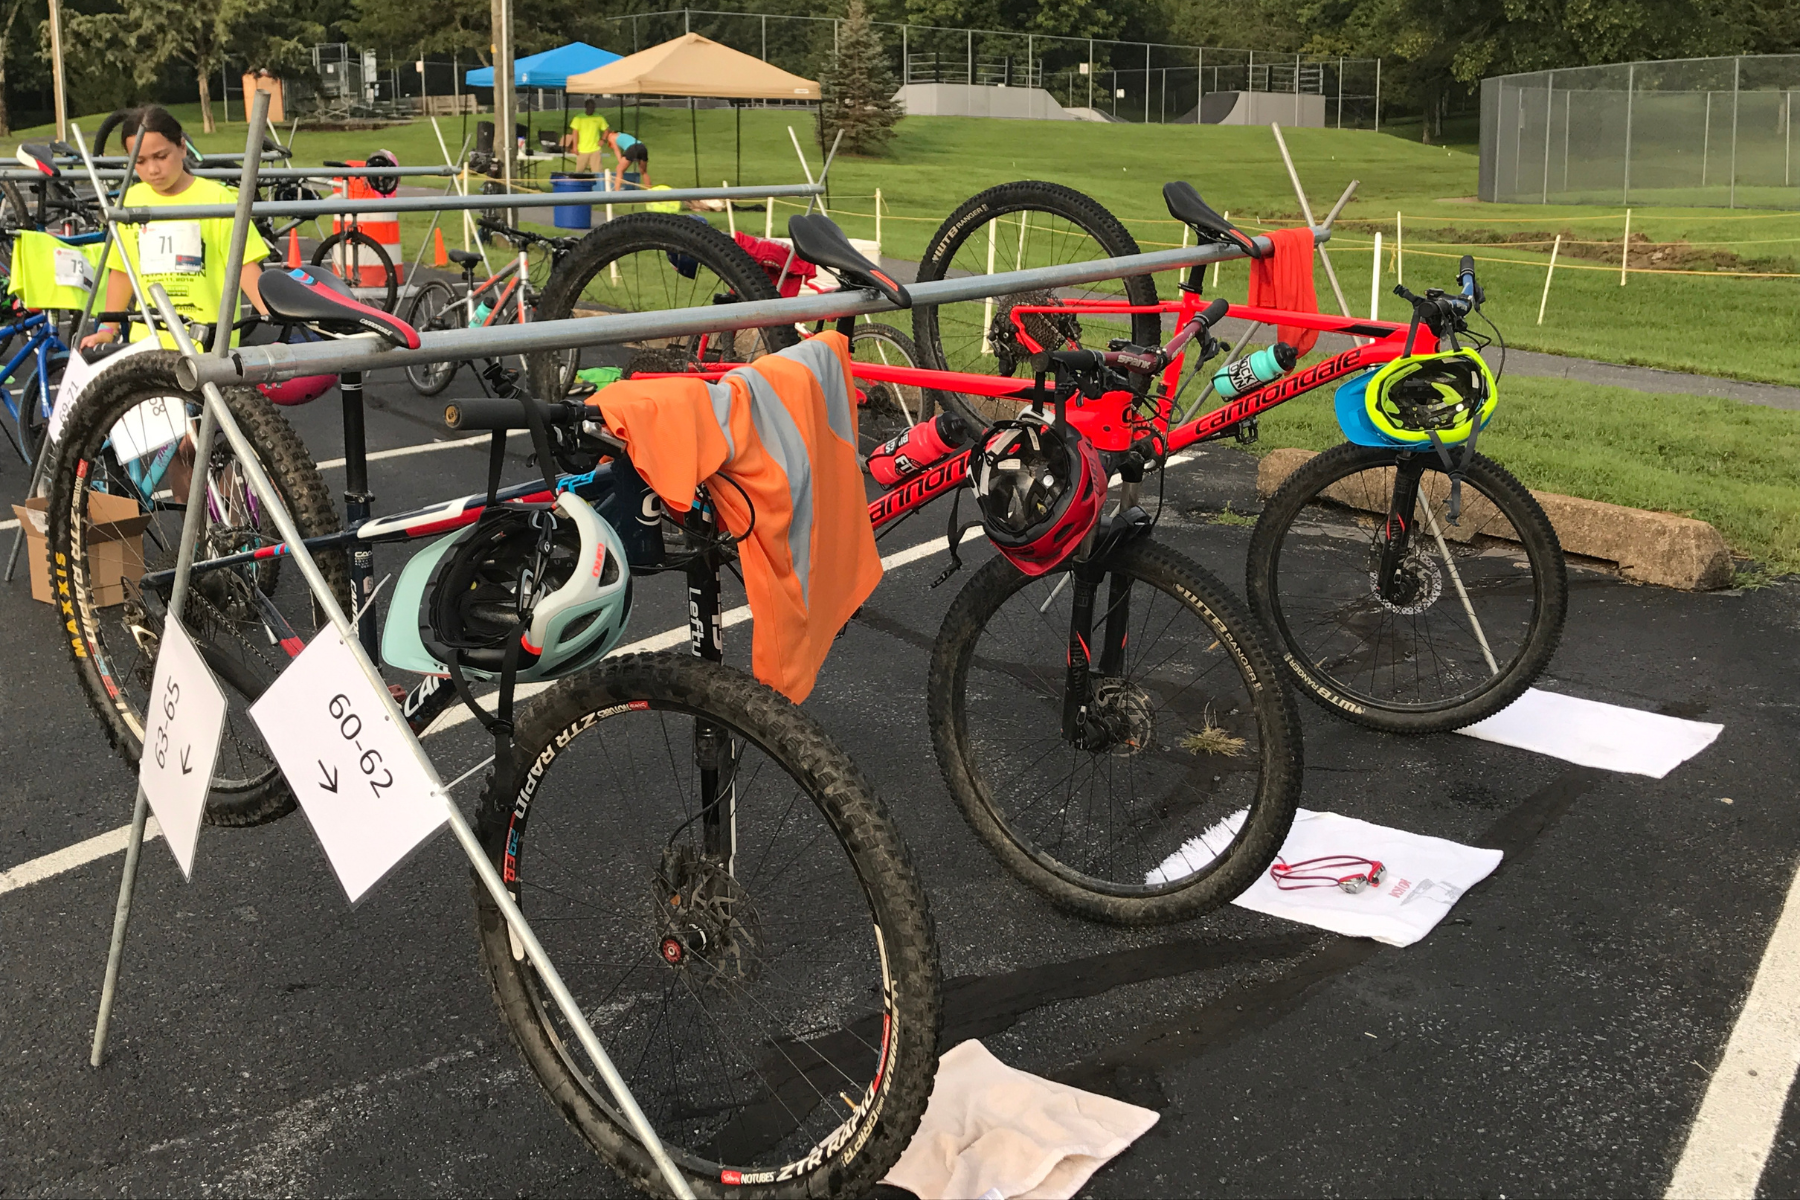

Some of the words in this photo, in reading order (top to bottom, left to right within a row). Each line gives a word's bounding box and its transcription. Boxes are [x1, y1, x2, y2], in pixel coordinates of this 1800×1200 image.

[956, 207, 983, 229] RANGER
[71, 259, 85, 274] 73
[159, 235, 172, 254] 71
[557, 471, 596, 493] F29
[591, 542, 605, 578] GIRO
[55, 552, 87, 659] MAXXIS
[1225, 632, 1256, 682] RANGER
[1288, 660, 1319, 690] RANGER
[155, 675, 180, 770] 63-65
[328, 693, 394, 799] 60-62
[555, 711, 598, 748] ZTR
[514, 744, 556, 819] RAPID
[506, 828, 519, 882] 29ER
[882, 1003, 900, 1096] MICHELIN
[740, 1171, 775, 1184] NOTUBES
[776, 1148, 824, 1183] ZTR
[826, 1080, 875, 1158] RAPID
